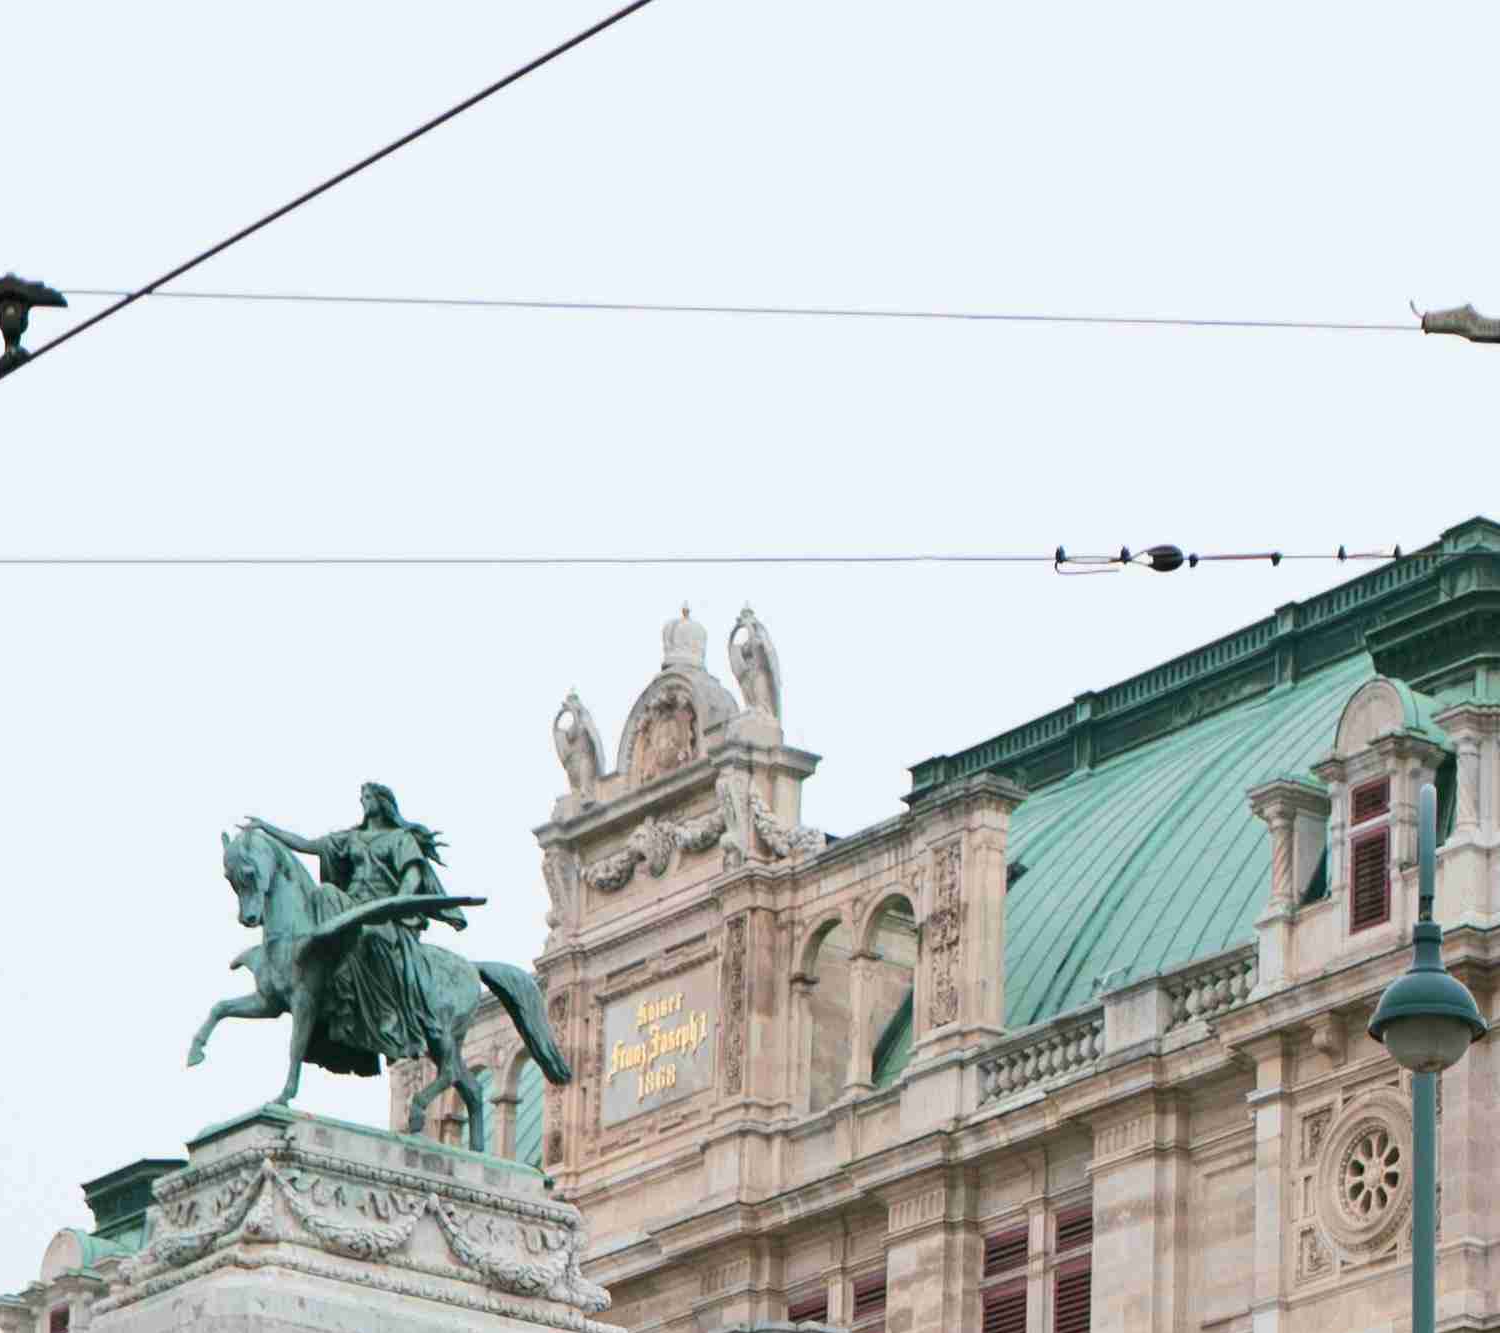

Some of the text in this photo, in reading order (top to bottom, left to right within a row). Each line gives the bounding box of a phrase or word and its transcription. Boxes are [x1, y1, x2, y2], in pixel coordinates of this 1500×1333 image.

[636, 991, 683, 1026] Kaiser
[606, 1040, 646, 1087] Franz
[647, 1010, 698, 1060] Joseph
[638, 1062, 677, 1105] 1868
